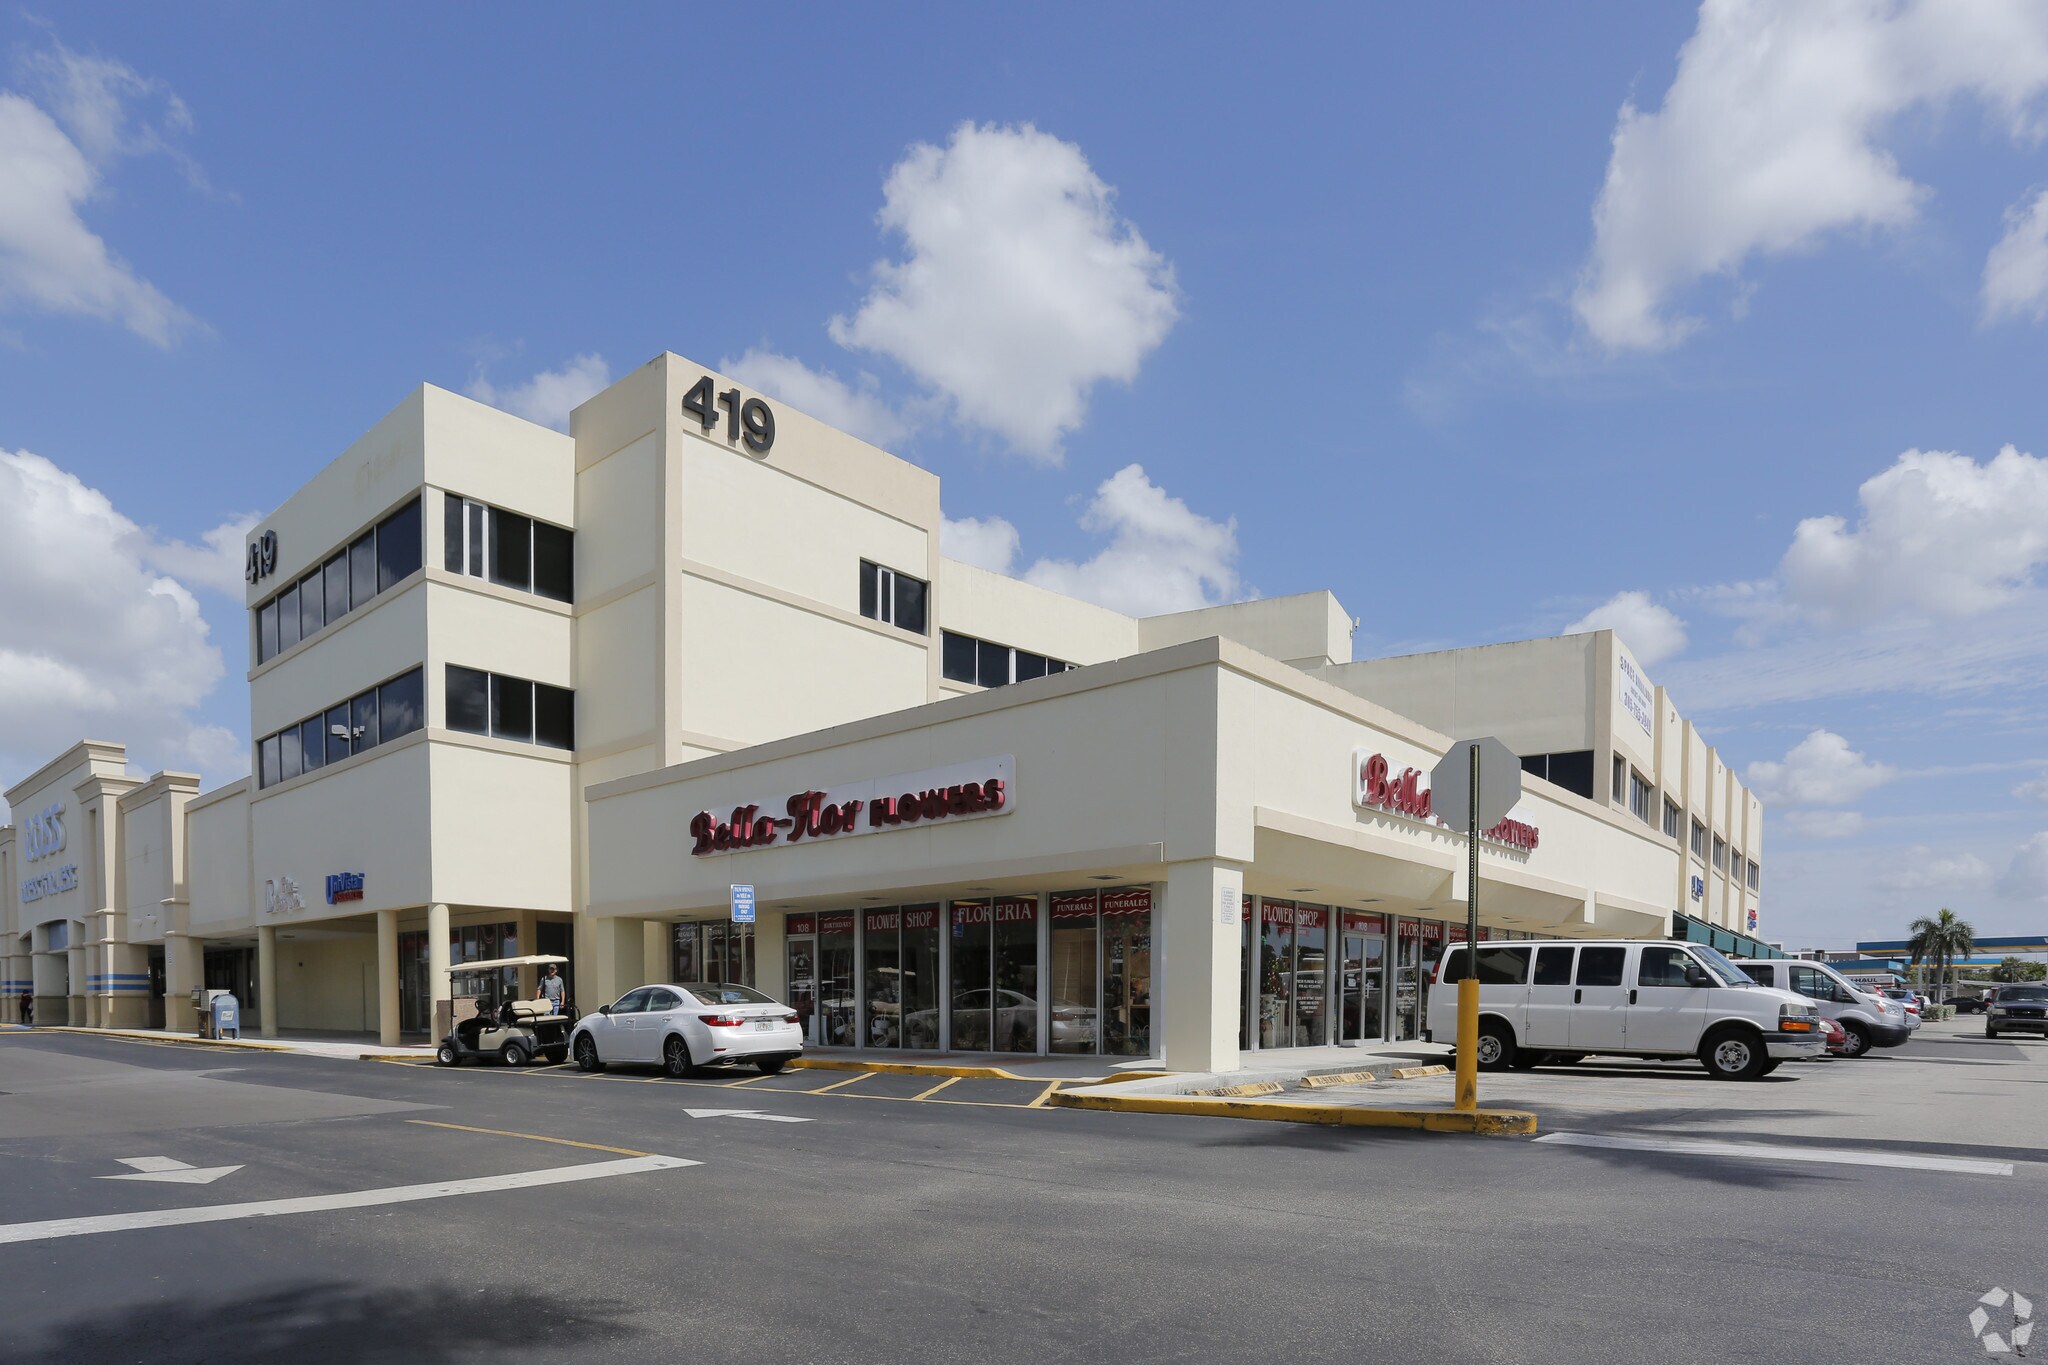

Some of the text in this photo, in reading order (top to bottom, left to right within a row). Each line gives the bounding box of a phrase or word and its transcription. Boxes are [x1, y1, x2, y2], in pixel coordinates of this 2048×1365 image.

[682, 375, 776, 452] 419
[245, 529, 278, 585] 419
[690, 778, 1005, 856] Bella-Flor FLOWERS
[1481, 816, 1539, 849] OWERS
[1056, 902, 1093, 912] FUNERALS
[1104, 898, 1148, 909] FUNERALES
[867, 911, 932, 930] FLOWER SHOP
[1263, 904, 1319, 926] FLOWER SHOP
[797, 923, 810, 933] 108
[1358, 921, 1368, 932] 108
